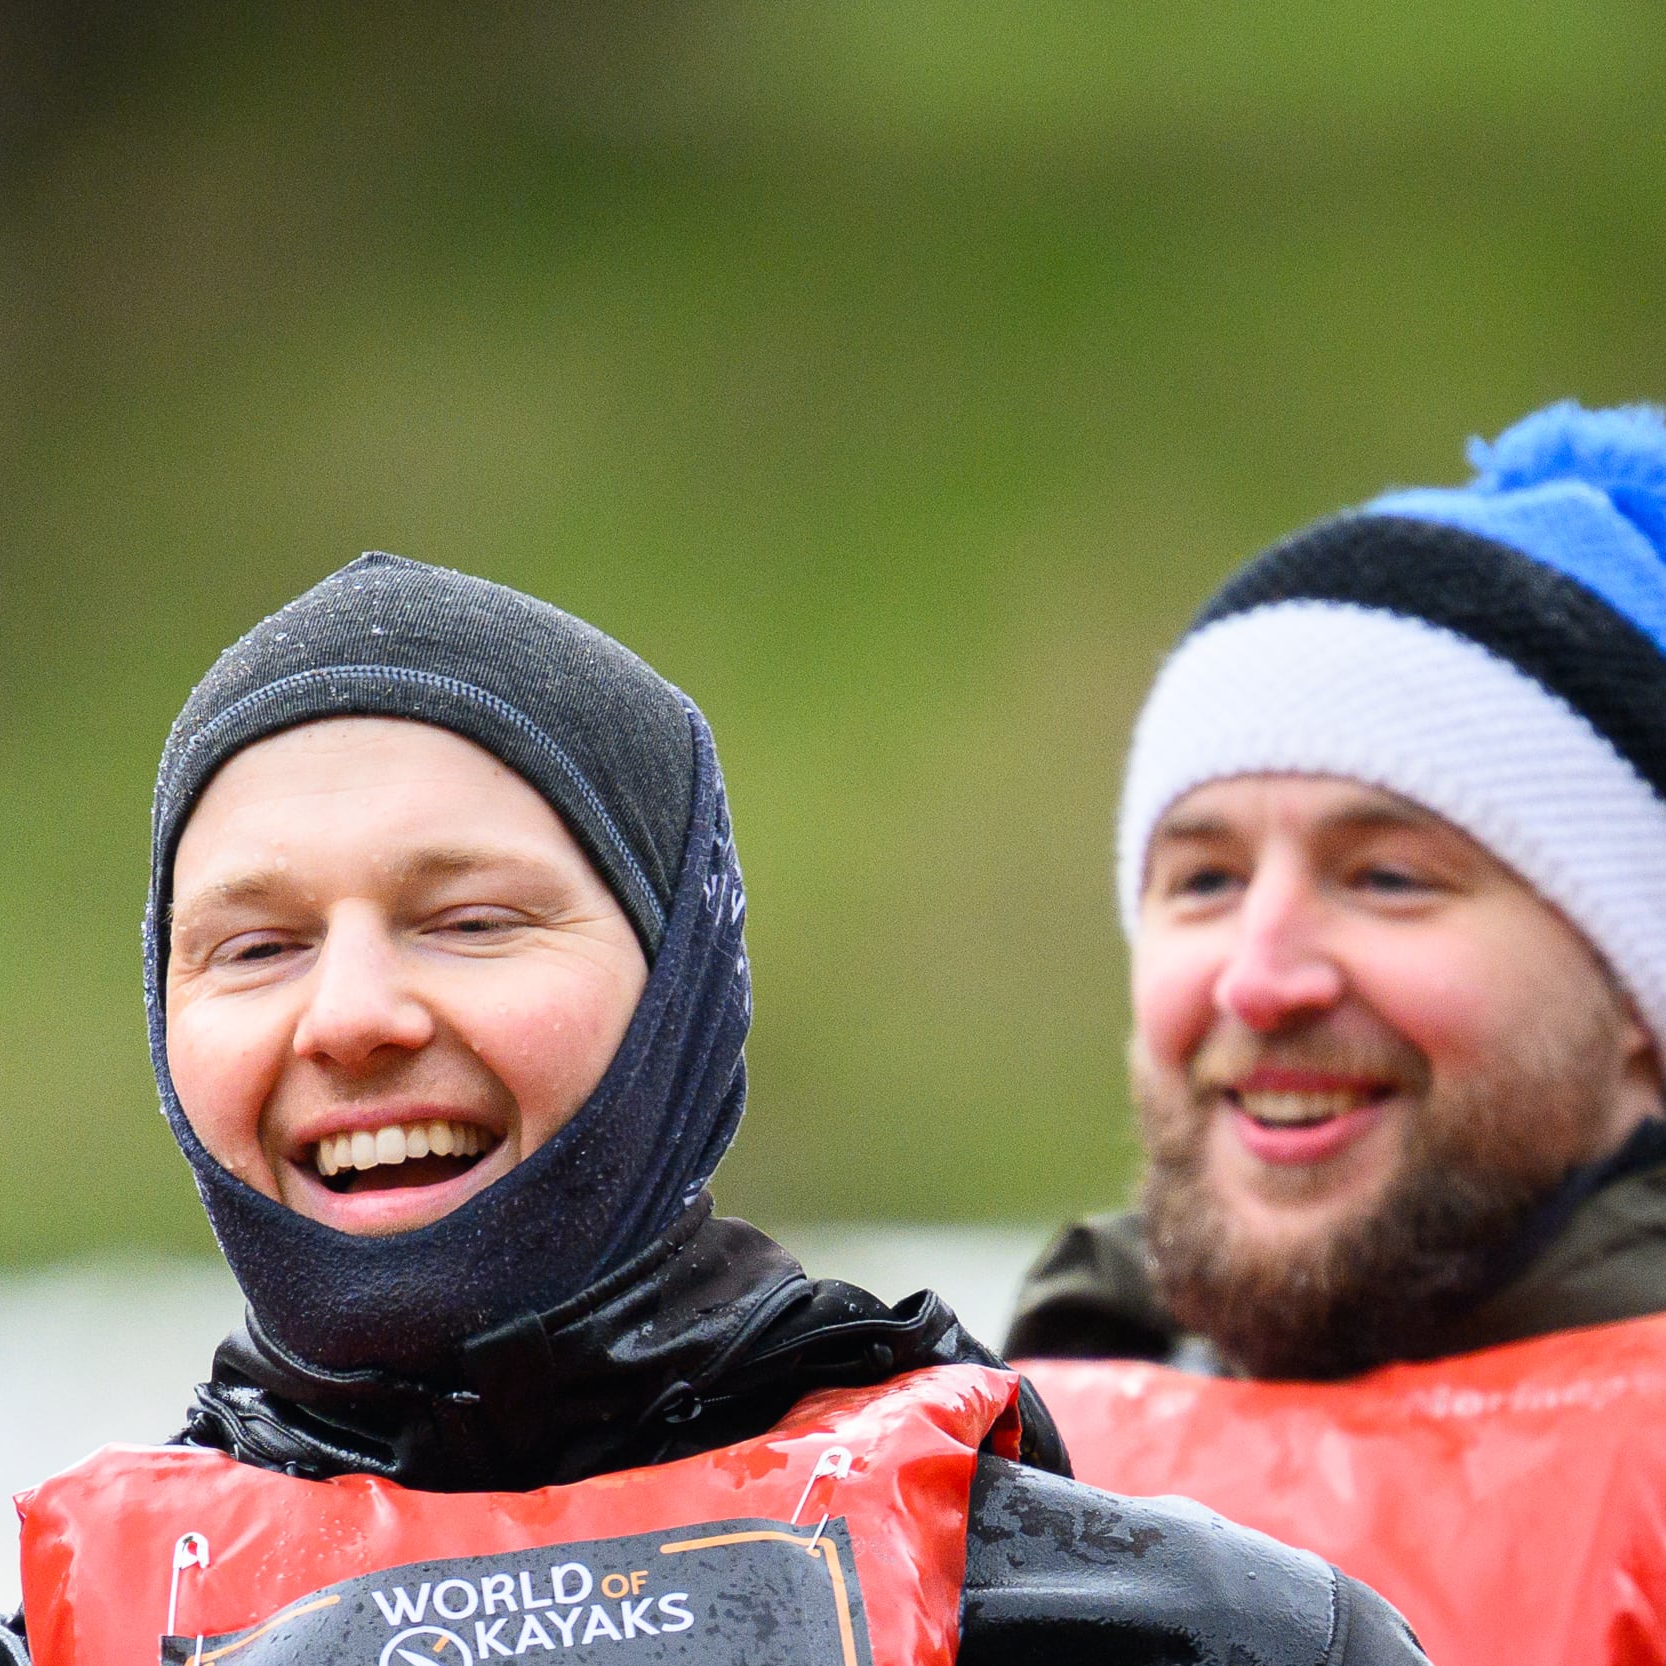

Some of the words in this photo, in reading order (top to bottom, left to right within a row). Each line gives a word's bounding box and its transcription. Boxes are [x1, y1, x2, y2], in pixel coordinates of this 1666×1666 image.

[371, 1562, 593, 1626] WORLD
[601, 1570, 649, 1599] OF
[474, 1592, 695, 1659] KAYAKS
